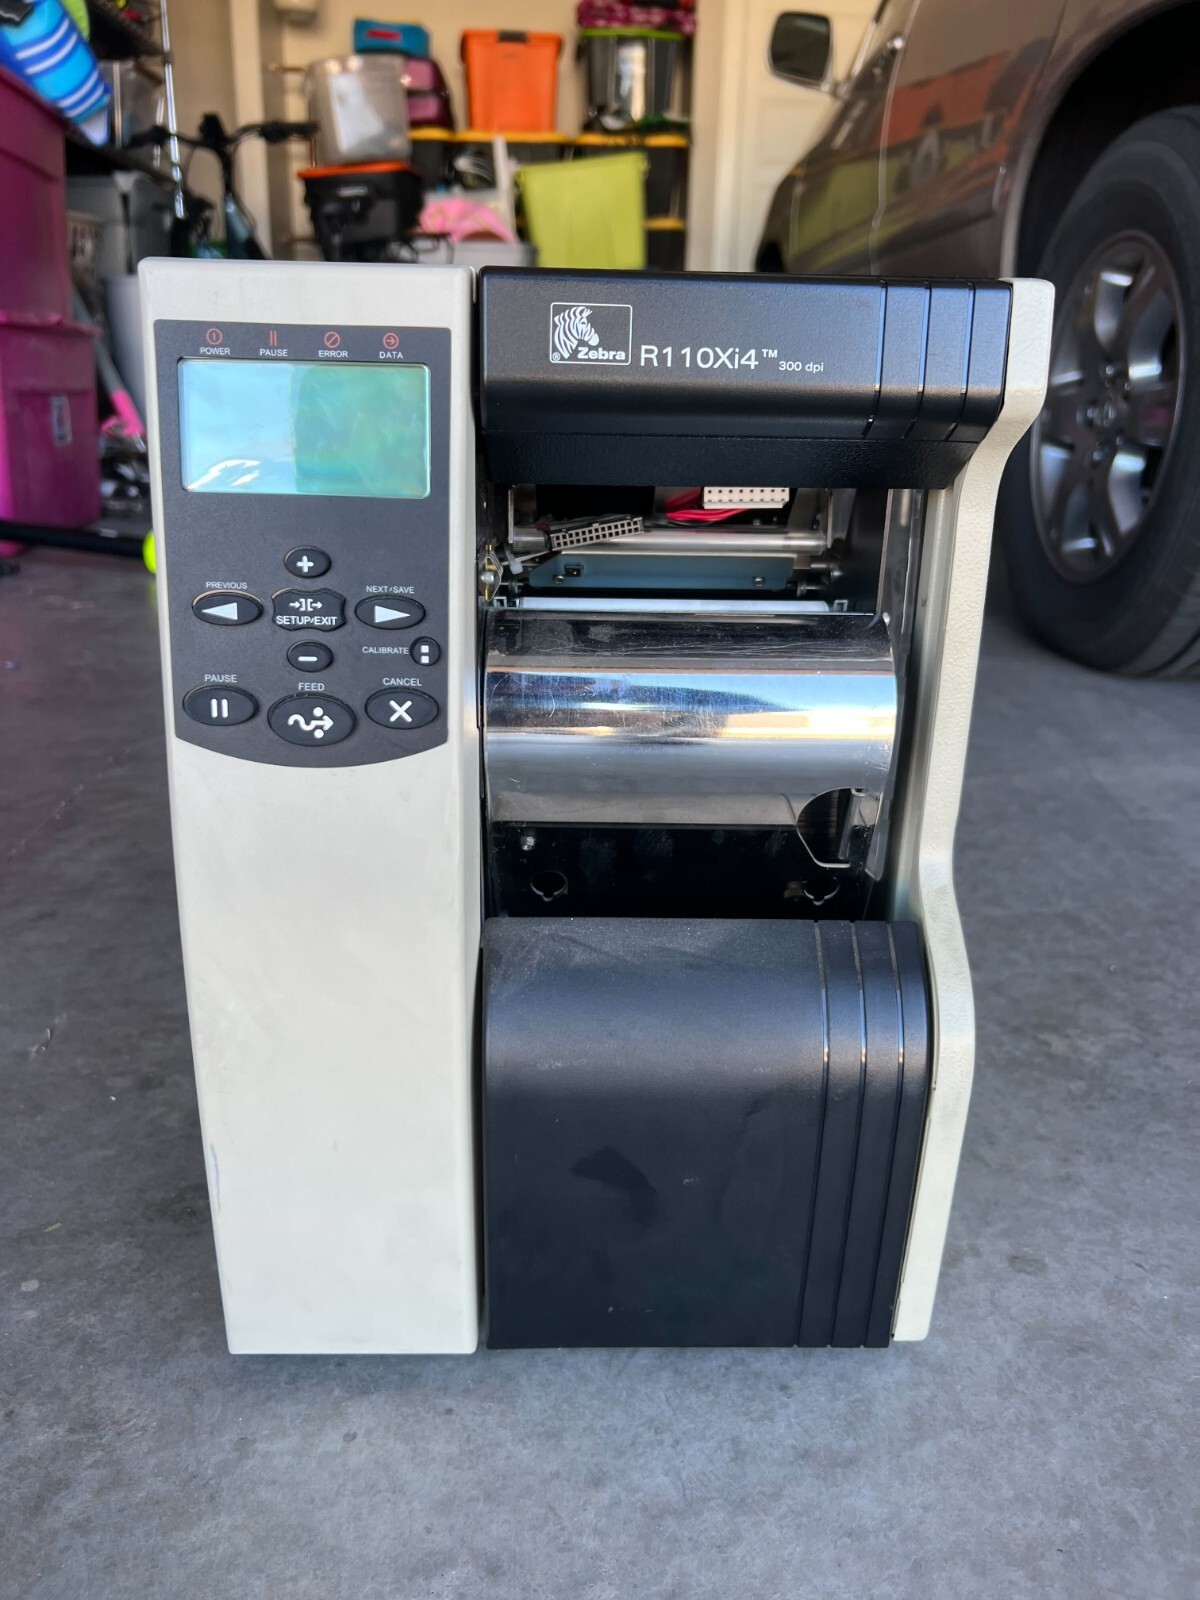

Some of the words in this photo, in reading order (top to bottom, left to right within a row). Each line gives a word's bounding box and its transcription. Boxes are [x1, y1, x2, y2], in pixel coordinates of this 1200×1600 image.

[200, 346, 231, 356] POWER
[259, 348, 288, 357] PAUSE
[318, 349, 349, 358] ERROR
[379, 351, 403, 359] DATA
[577, 346, 626, 361] Zebra
[778, 360, 802, 372] 300
[805, 361, 824, 373] dpi
[205, 581, 248, 590] PREVIOUS
[362, 646, 410, 655] CALIBRATE
[204, 674, 238, 683] PAUSE
[382, 677, 422, 687] CANCEL
[298, 682, 325, 692] FEED
